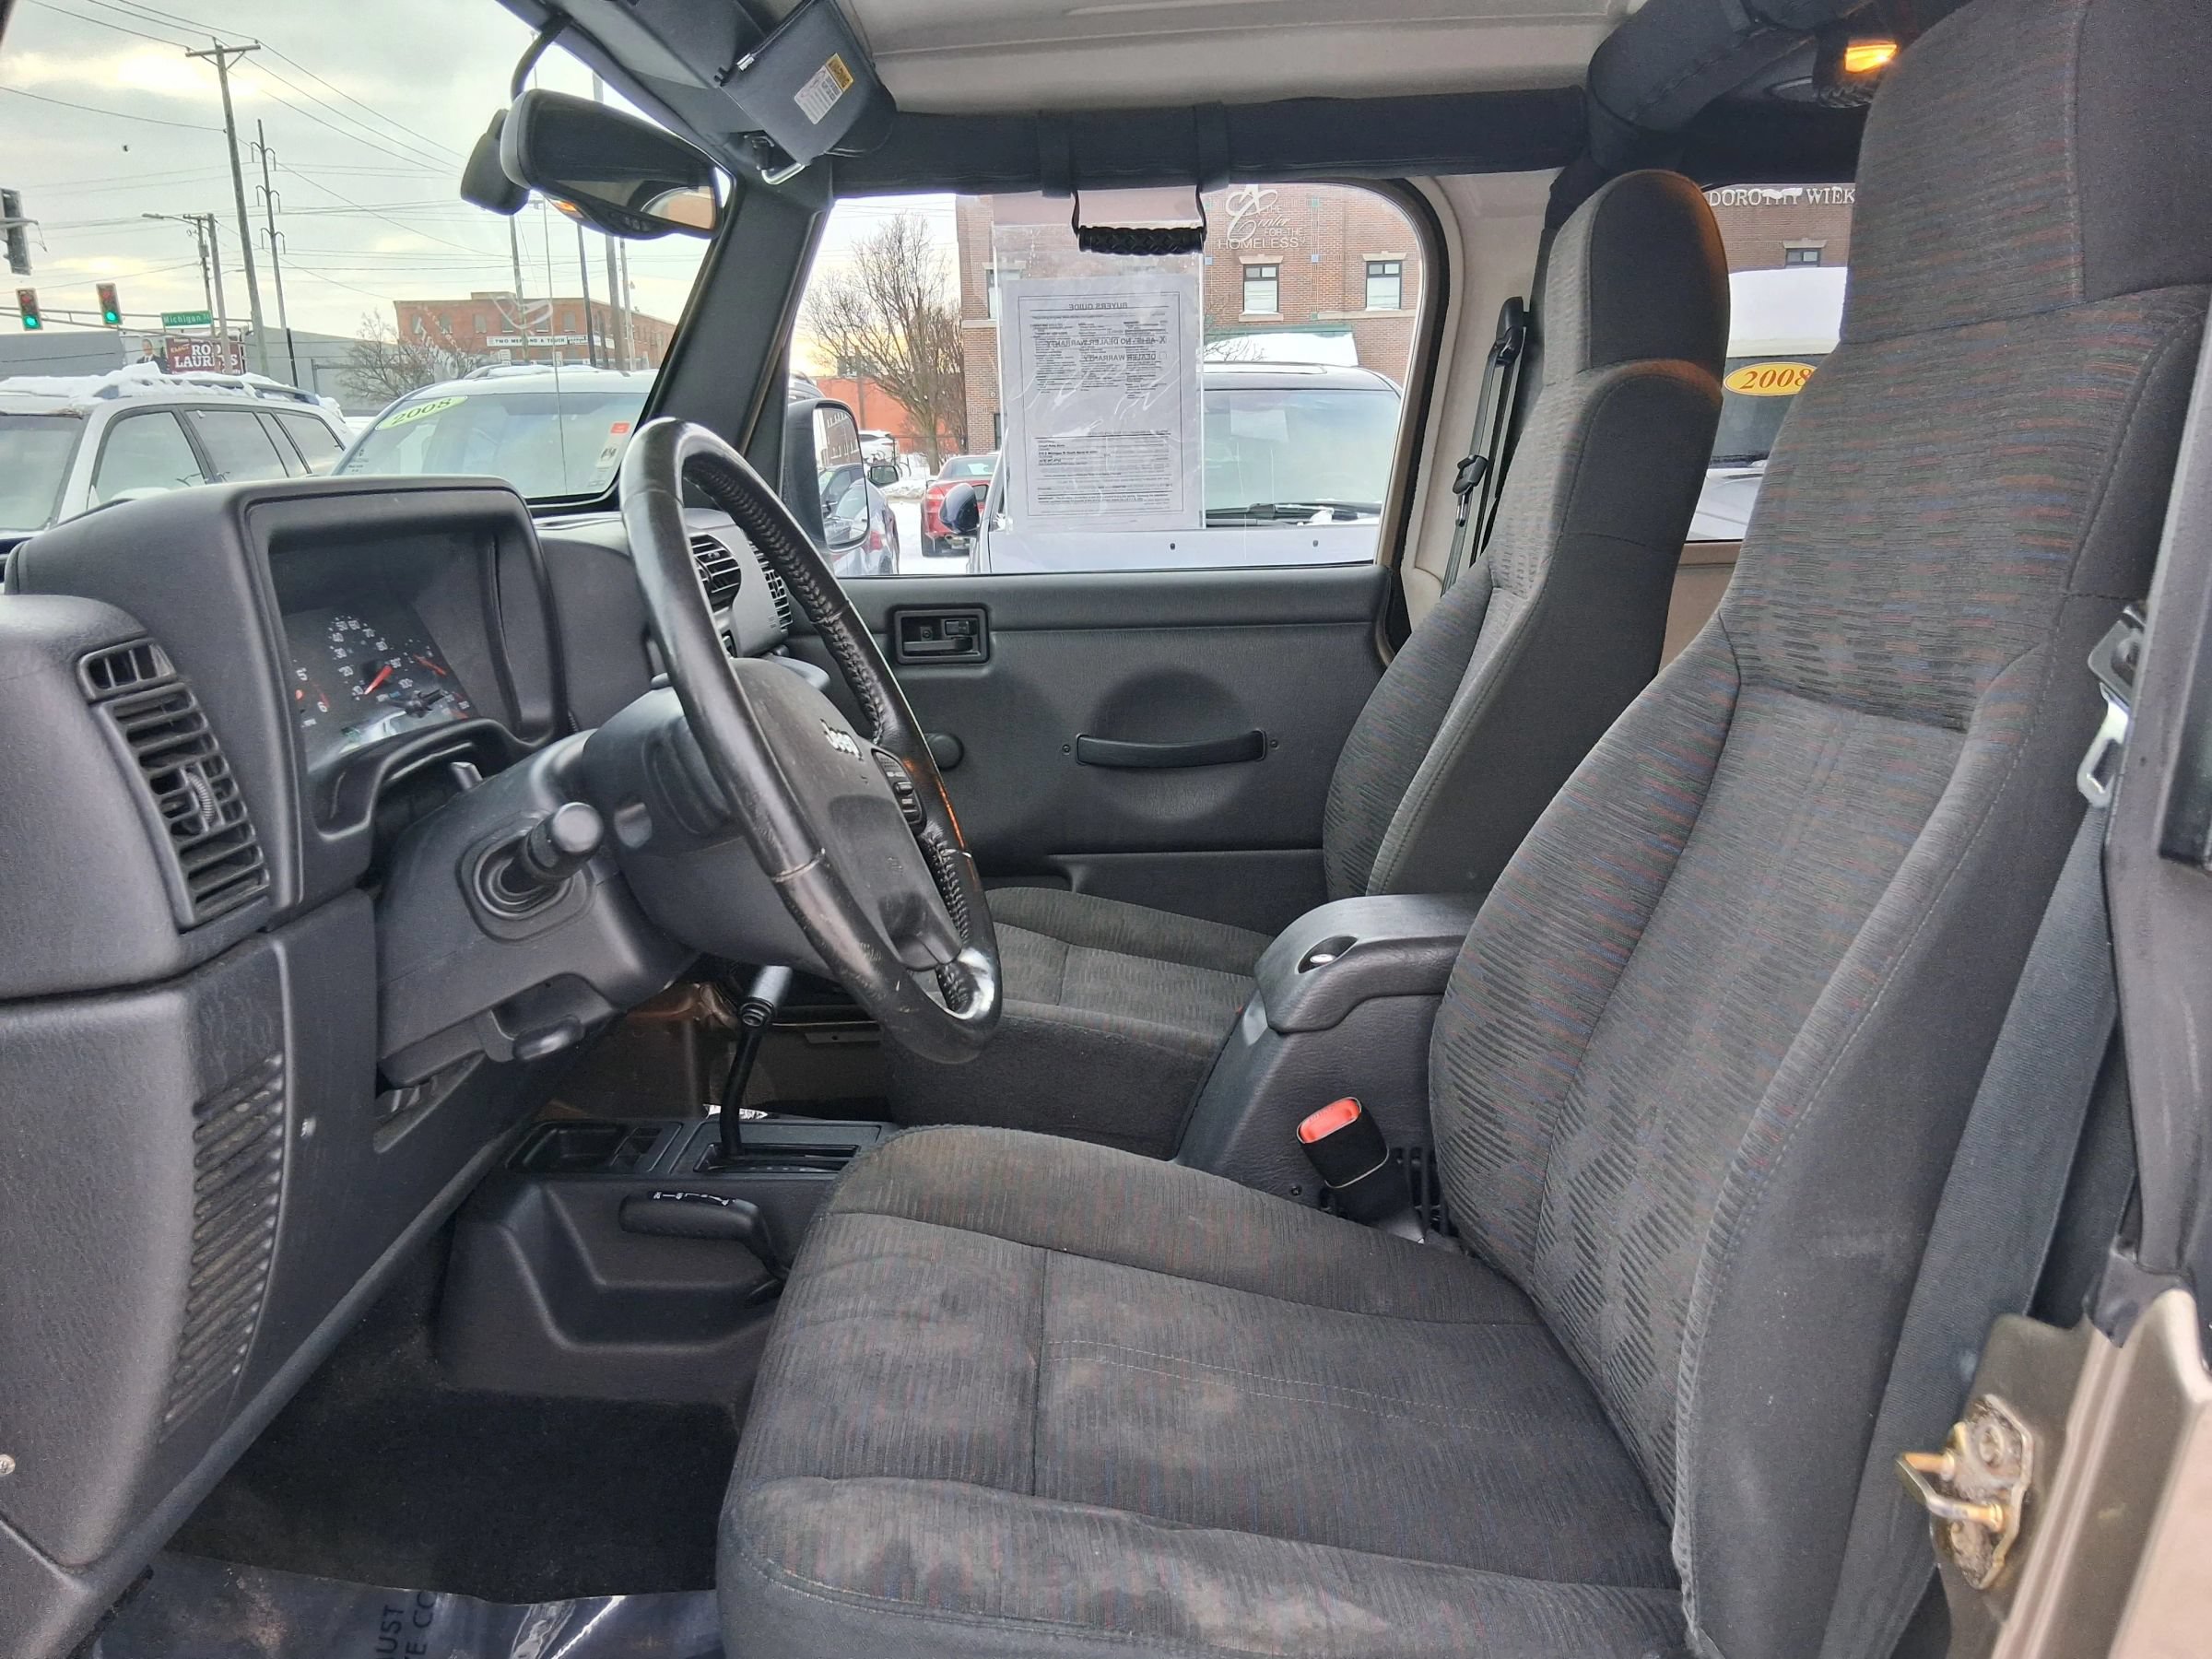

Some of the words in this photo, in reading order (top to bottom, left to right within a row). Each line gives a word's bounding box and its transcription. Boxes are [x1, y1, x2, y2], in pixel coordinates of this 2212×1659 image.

[1709, 188, 1799, 206] DORO
[1264, 228, 1281, 237] FOR
[1288, 228, 1304, 237] THE
[1218, 237, 1299, 250] HOMELESS
[163, 314, 201, 324] Michigan
[1739, 368, 1814, 389] 2008
[391, 397, 452, 426] 2008
[295, 667, 308, 681] 5
[317, 700, 328, 712] 6
[375, 1605, 404, 1659] UST
